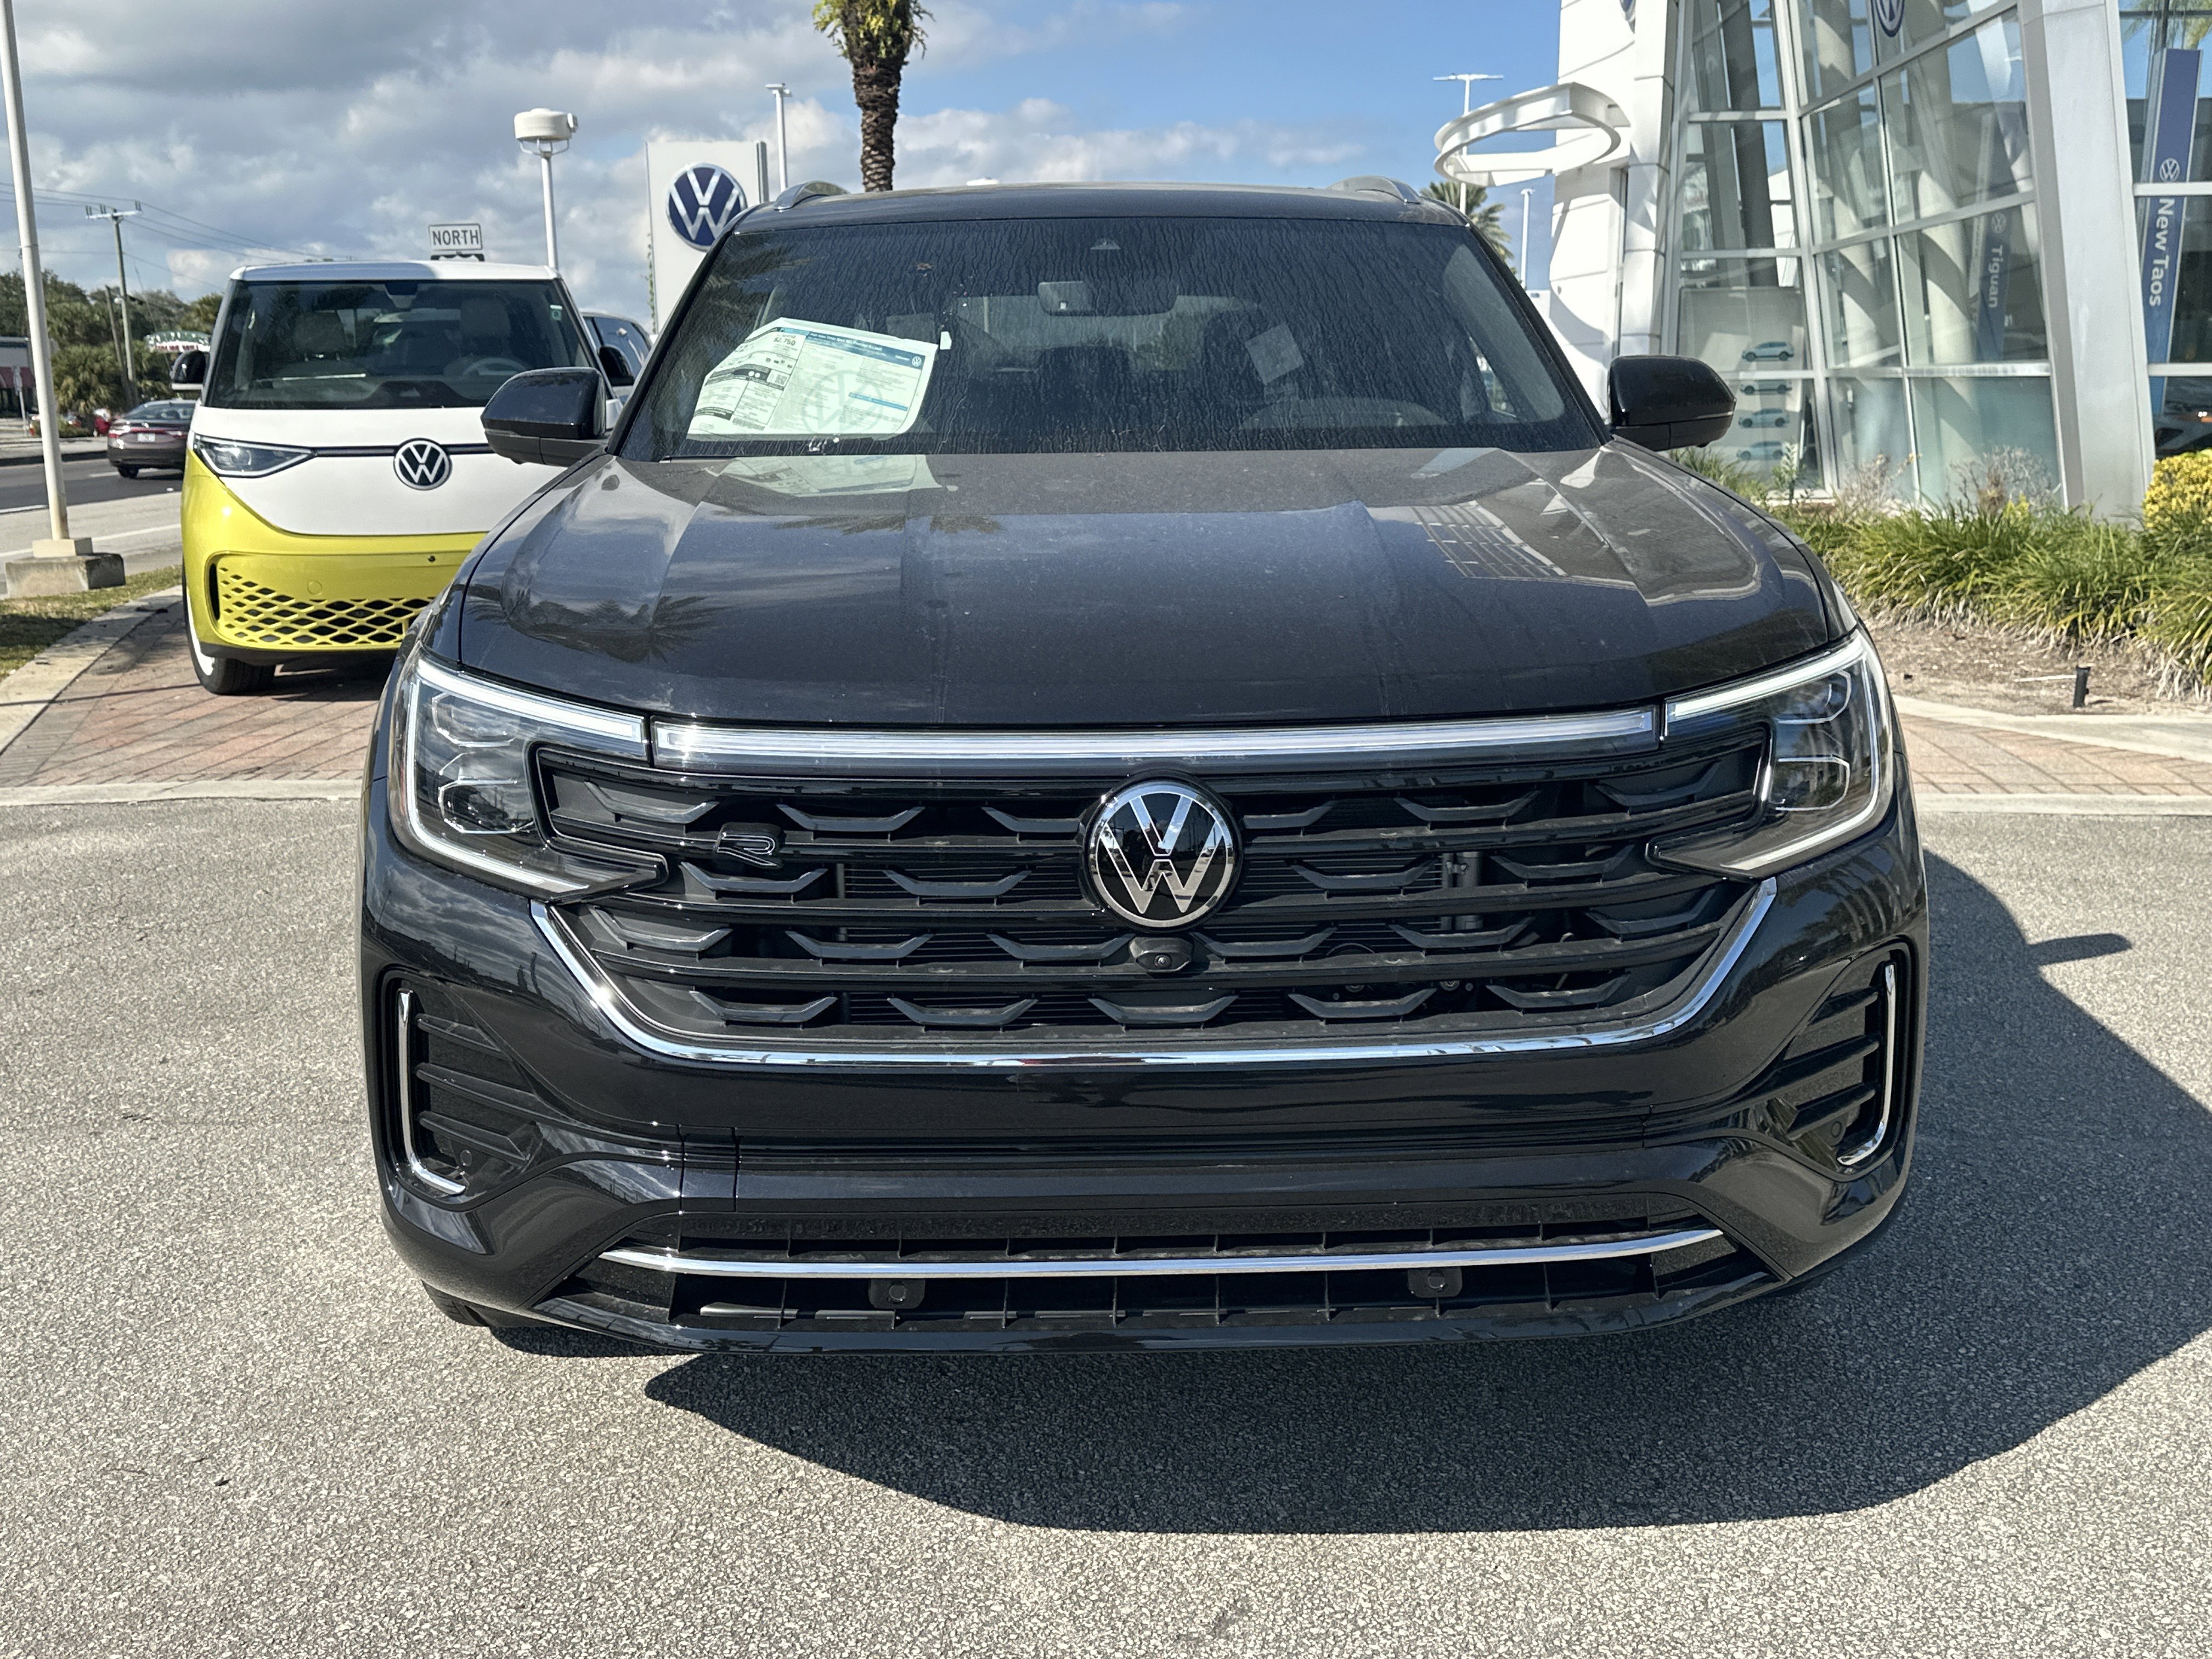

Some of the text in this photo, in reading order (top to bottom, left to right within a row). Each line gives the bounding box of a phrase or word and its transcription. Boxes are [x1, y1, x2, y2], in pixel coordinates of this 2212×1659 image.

[432, 229, 479, 245] NORTH
[668, 166, 743, 248] VW
[1989, 245, 2004, 308] Tiguan
[2149, 198, 2175, 307] New Taos
[397, 442, 447, 486] VW
[1096, 790, 1227, 919] VW
